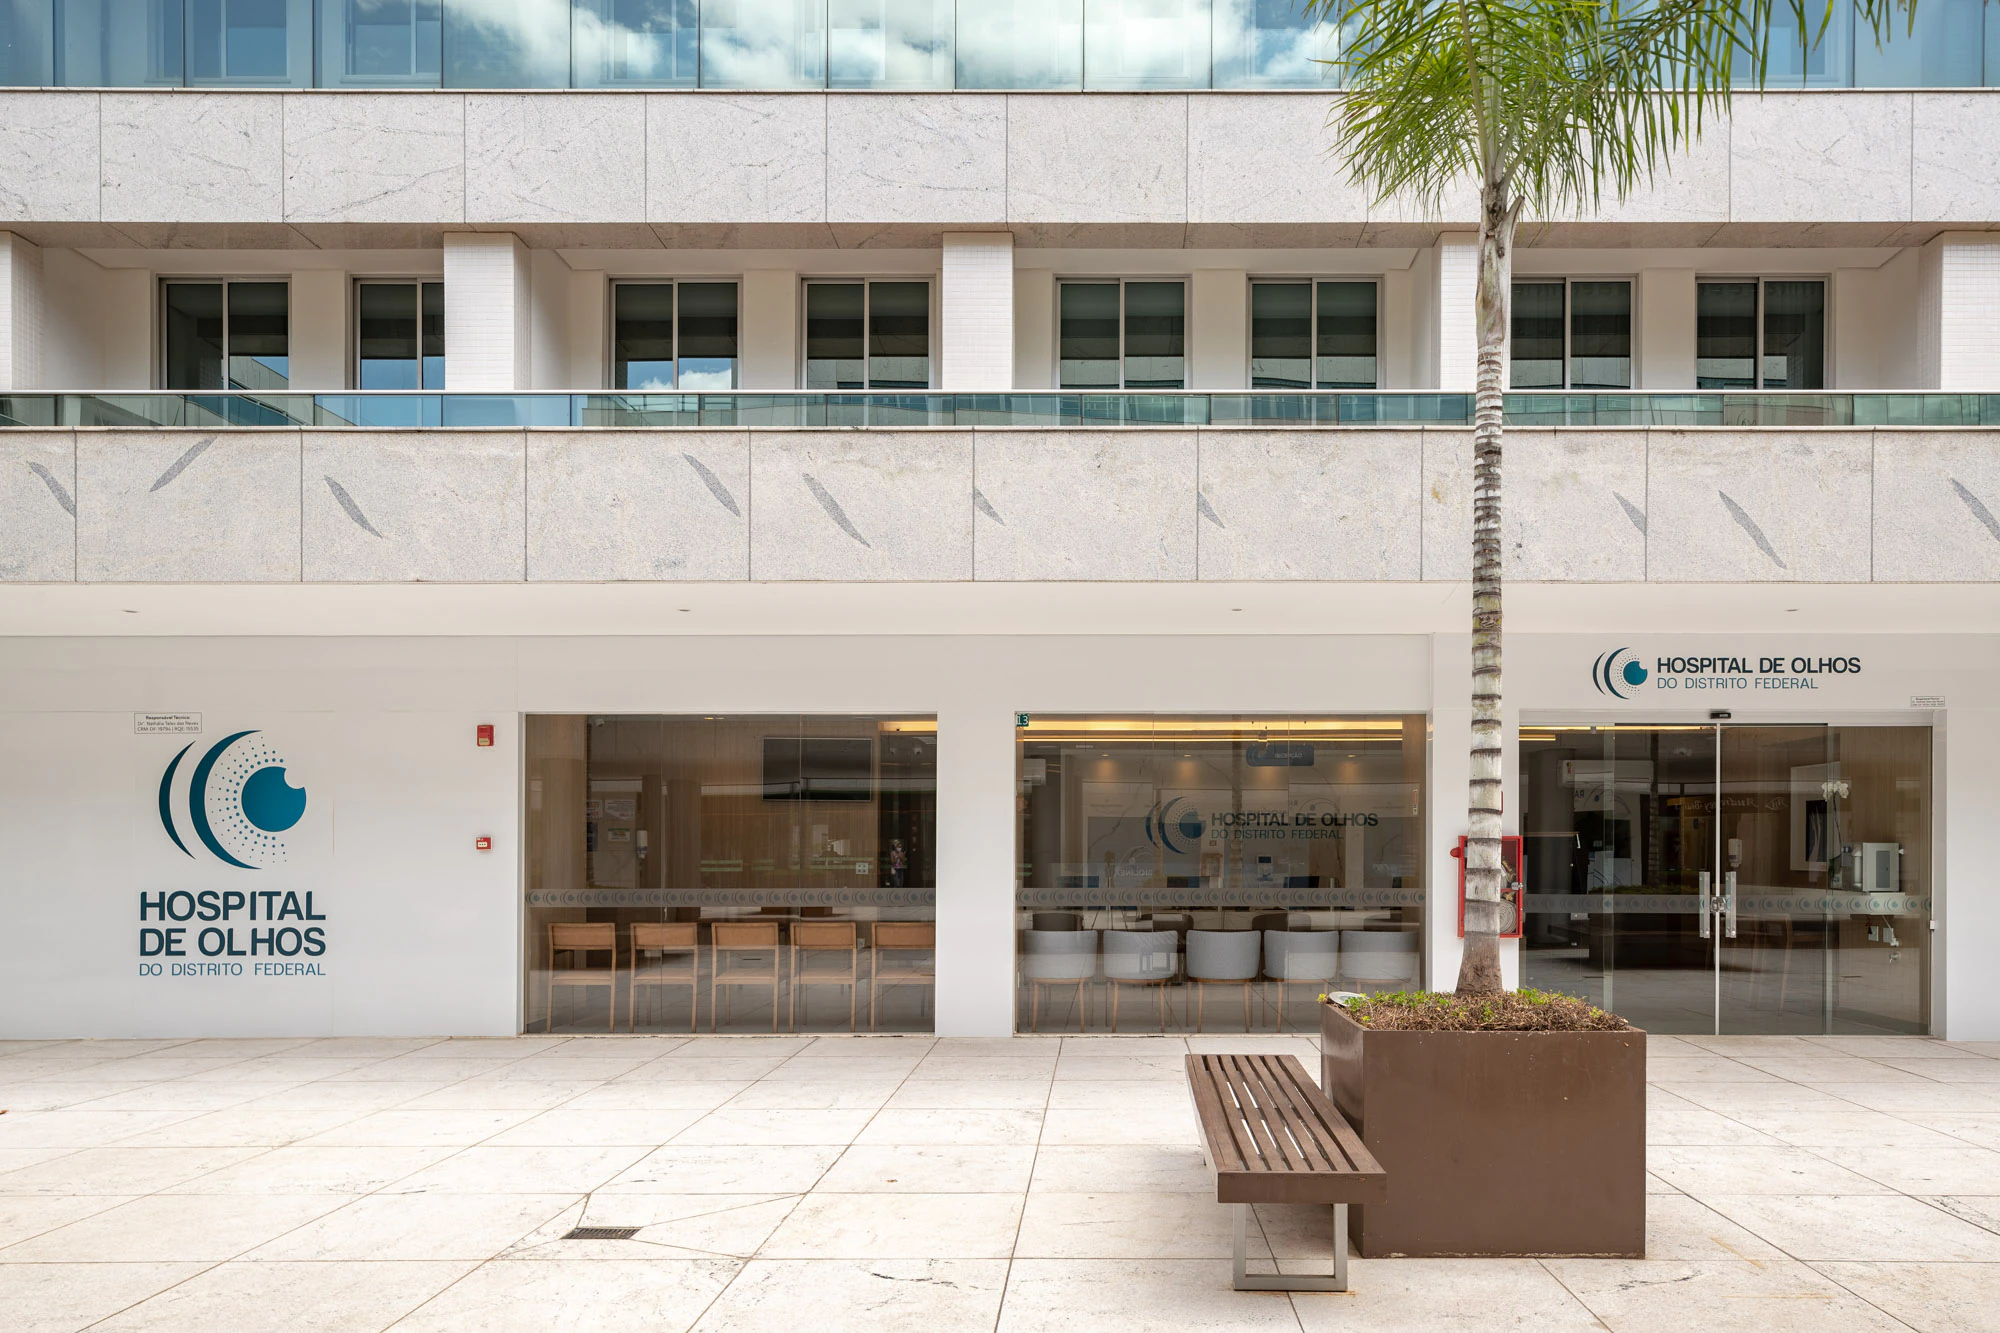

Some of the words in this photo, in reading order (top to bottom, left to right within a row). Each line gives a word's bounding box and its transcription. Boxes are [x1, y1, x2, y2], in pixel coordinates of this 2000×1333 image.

[1658, 657, 1754, 673] HOSPITAL
[1760, 658, 1786, 673] DE
[1791, 657, 1861, 673] OLHOS
[1658, 677, 1678, 689] DO
[1685, 677, 1748, 689] DISTRITO
[1755, 677, 1818, 689] FEDERAL
[1211, 813, 1289, 827] HOSPITAL
[1296, 813, 1316, 827] DE
[1321, 813, 1378, 827] OLHOS
[1211, 829, 1228, 839] DO
[1234, 829, 1287, 839] DISTRITO
[1291, 829, 1344, 839] FEDERAL
[140, 890, 326, 921] HOSPITAL
[140, 927, 186, 956] DE
[198, 927, 326, 956] OLHOS
[140, 963, 162, 976] DO
[172, 963, 242, 976] DISTRITO
[255, 963, 326, 976] FEDERAL
